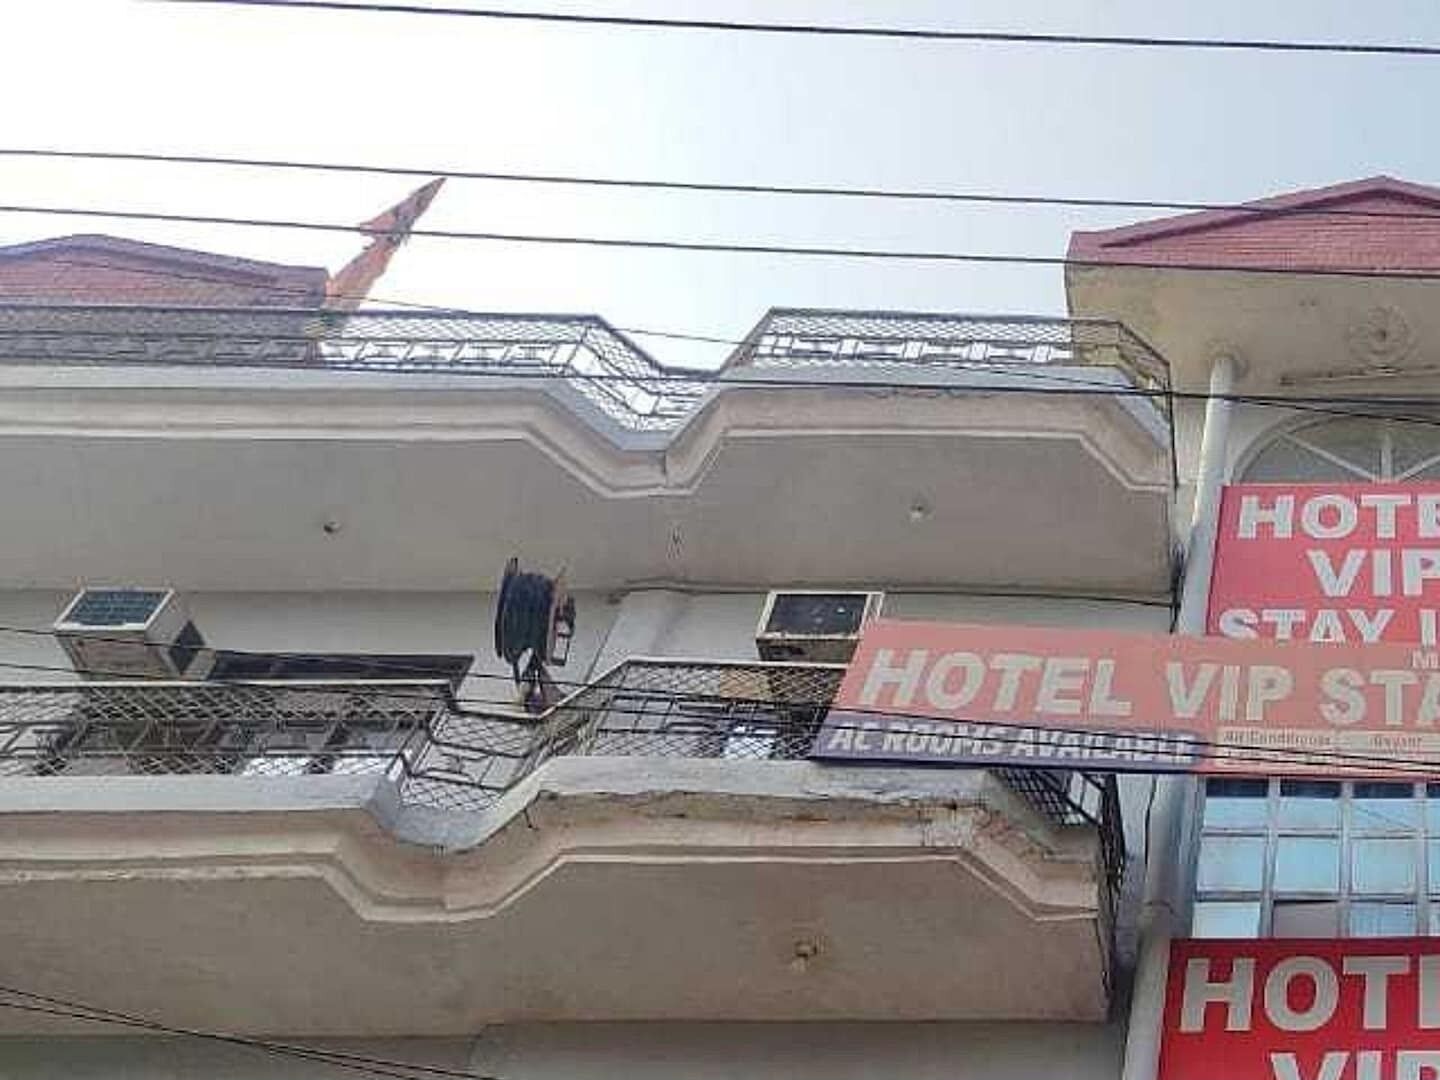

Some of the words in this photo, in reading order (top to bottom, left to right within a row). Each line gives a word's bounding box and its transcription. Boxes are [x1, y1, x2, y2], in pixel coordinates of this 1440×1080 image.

[1218, 608, 1395, 644] STAY
[860, 646, 1135, 717] HOTEL
[1165, 662, 1294, 725] VIP
[828, 721, 873, 752] AC
[882, 722, 1007, 756] ROOMS
[1010, 726, 1196, 764] AVAILABLE
